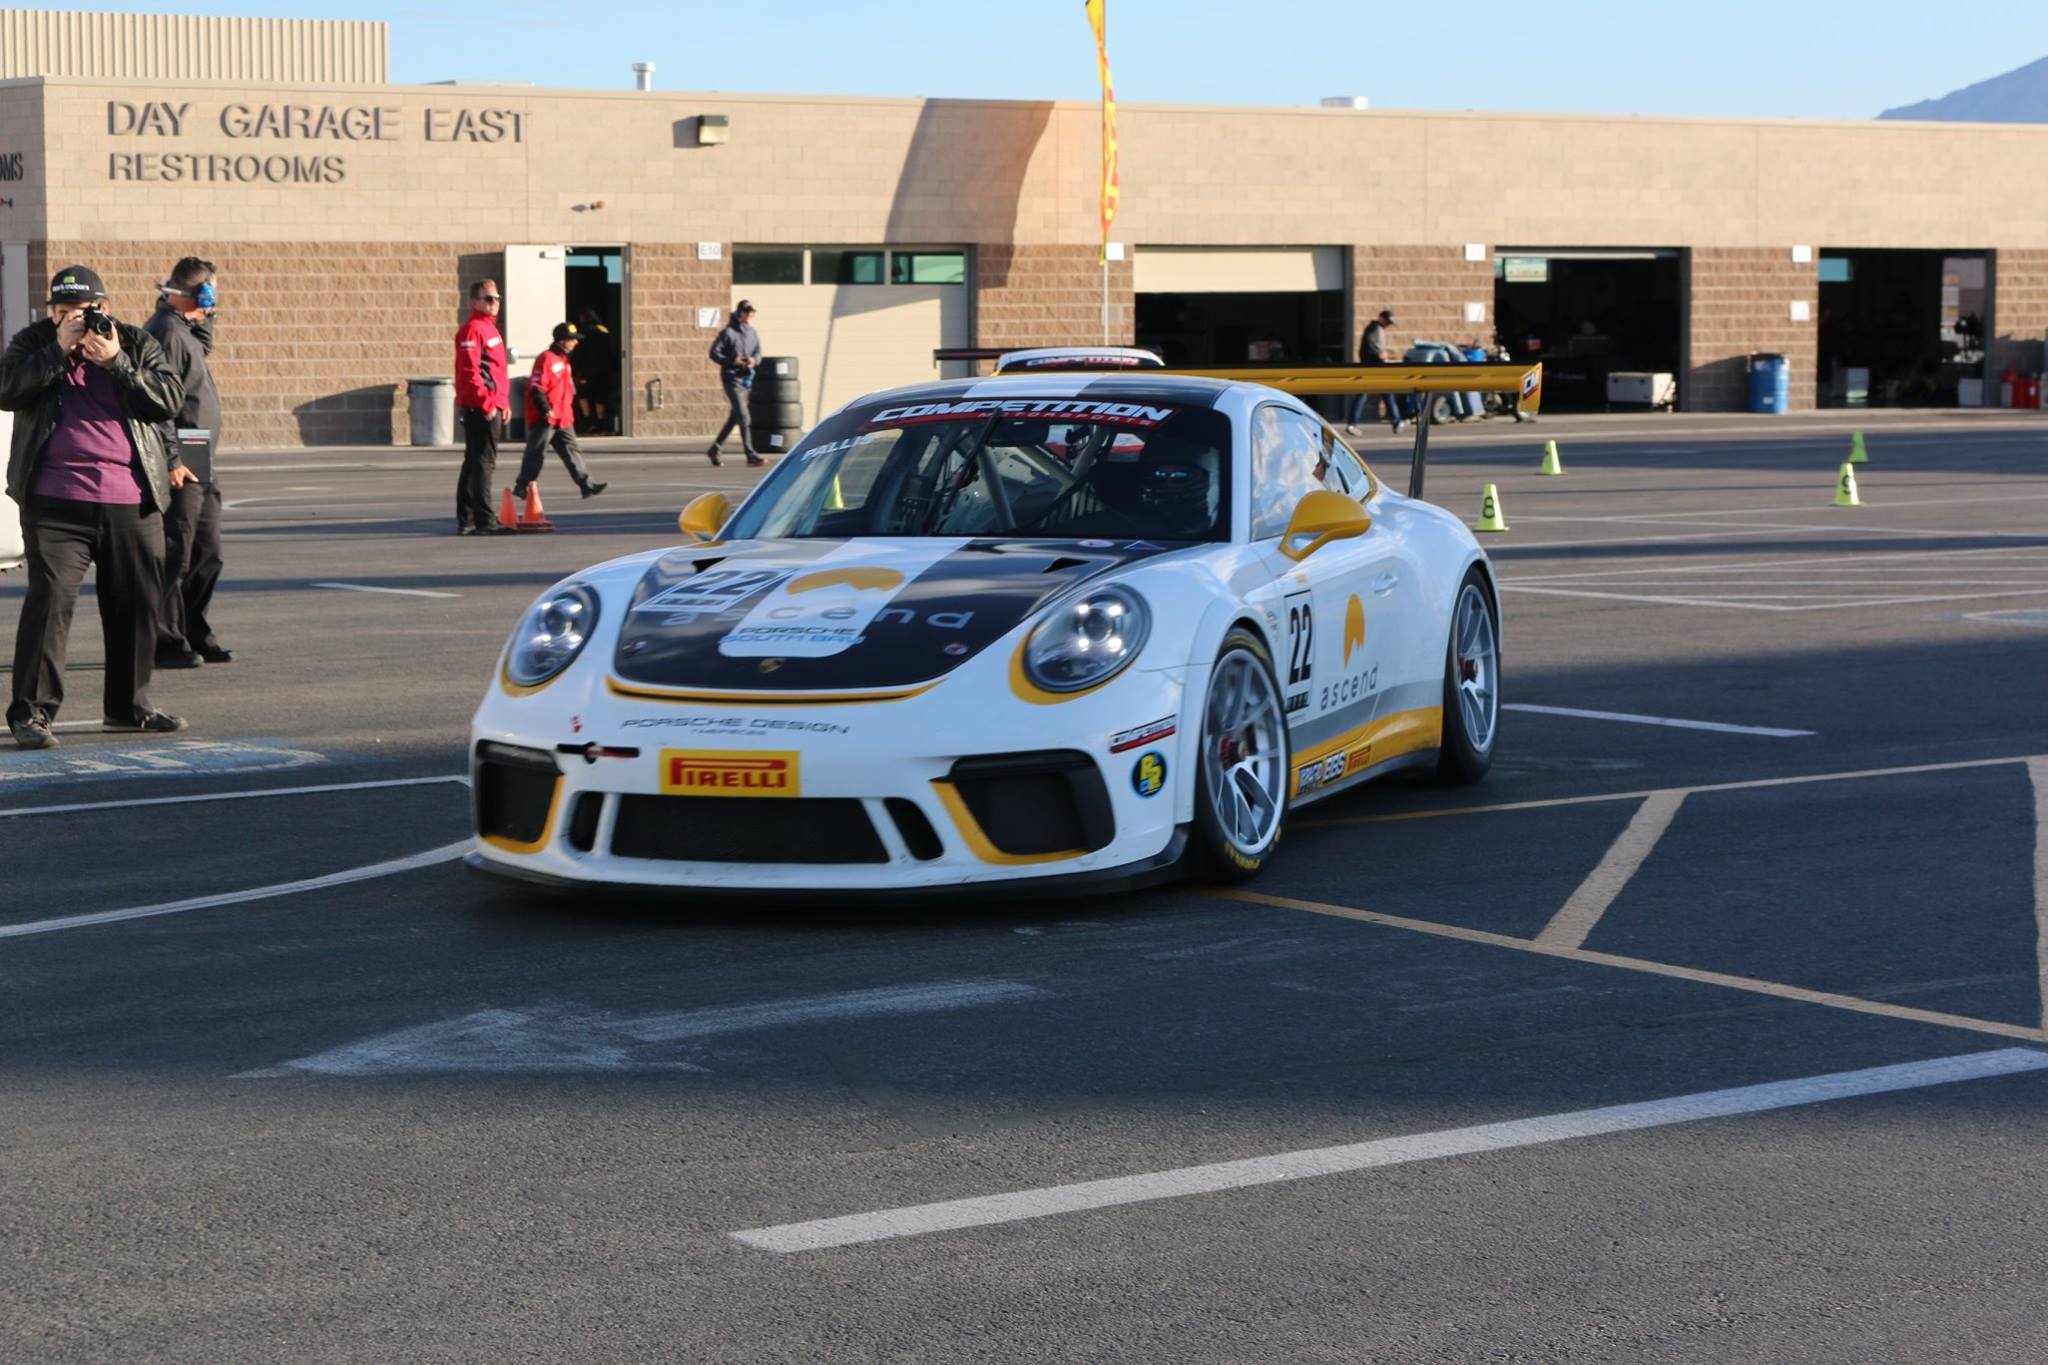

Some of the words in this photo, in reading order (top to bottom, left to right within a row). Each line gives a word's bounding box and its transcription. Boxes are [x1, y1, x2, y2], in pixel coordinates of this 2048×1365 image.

[107, 101, 189, 136] DAY
[219, 104, 400, 140] GARAGE
[424, 107, 531, 142] EAST
[109, 153, 345, 183] RESTROOMS
[871, 400, 1174, 423] COMPETITION
[1482, 496, 1495, 519] 8
[671, 570, 780, 597] 22
[661, 606, 976, 629] ascend
[738, 627, 857, 635] PORSCHE
[1289, 603, 1312, 686] 22
[1320, 661, 1379, 711] ascend
[621, 717, 744, 729] PORSCHE
[749, 718, 850, 734] DESIGN
[670, 757, 787, 788] PIRELLI
